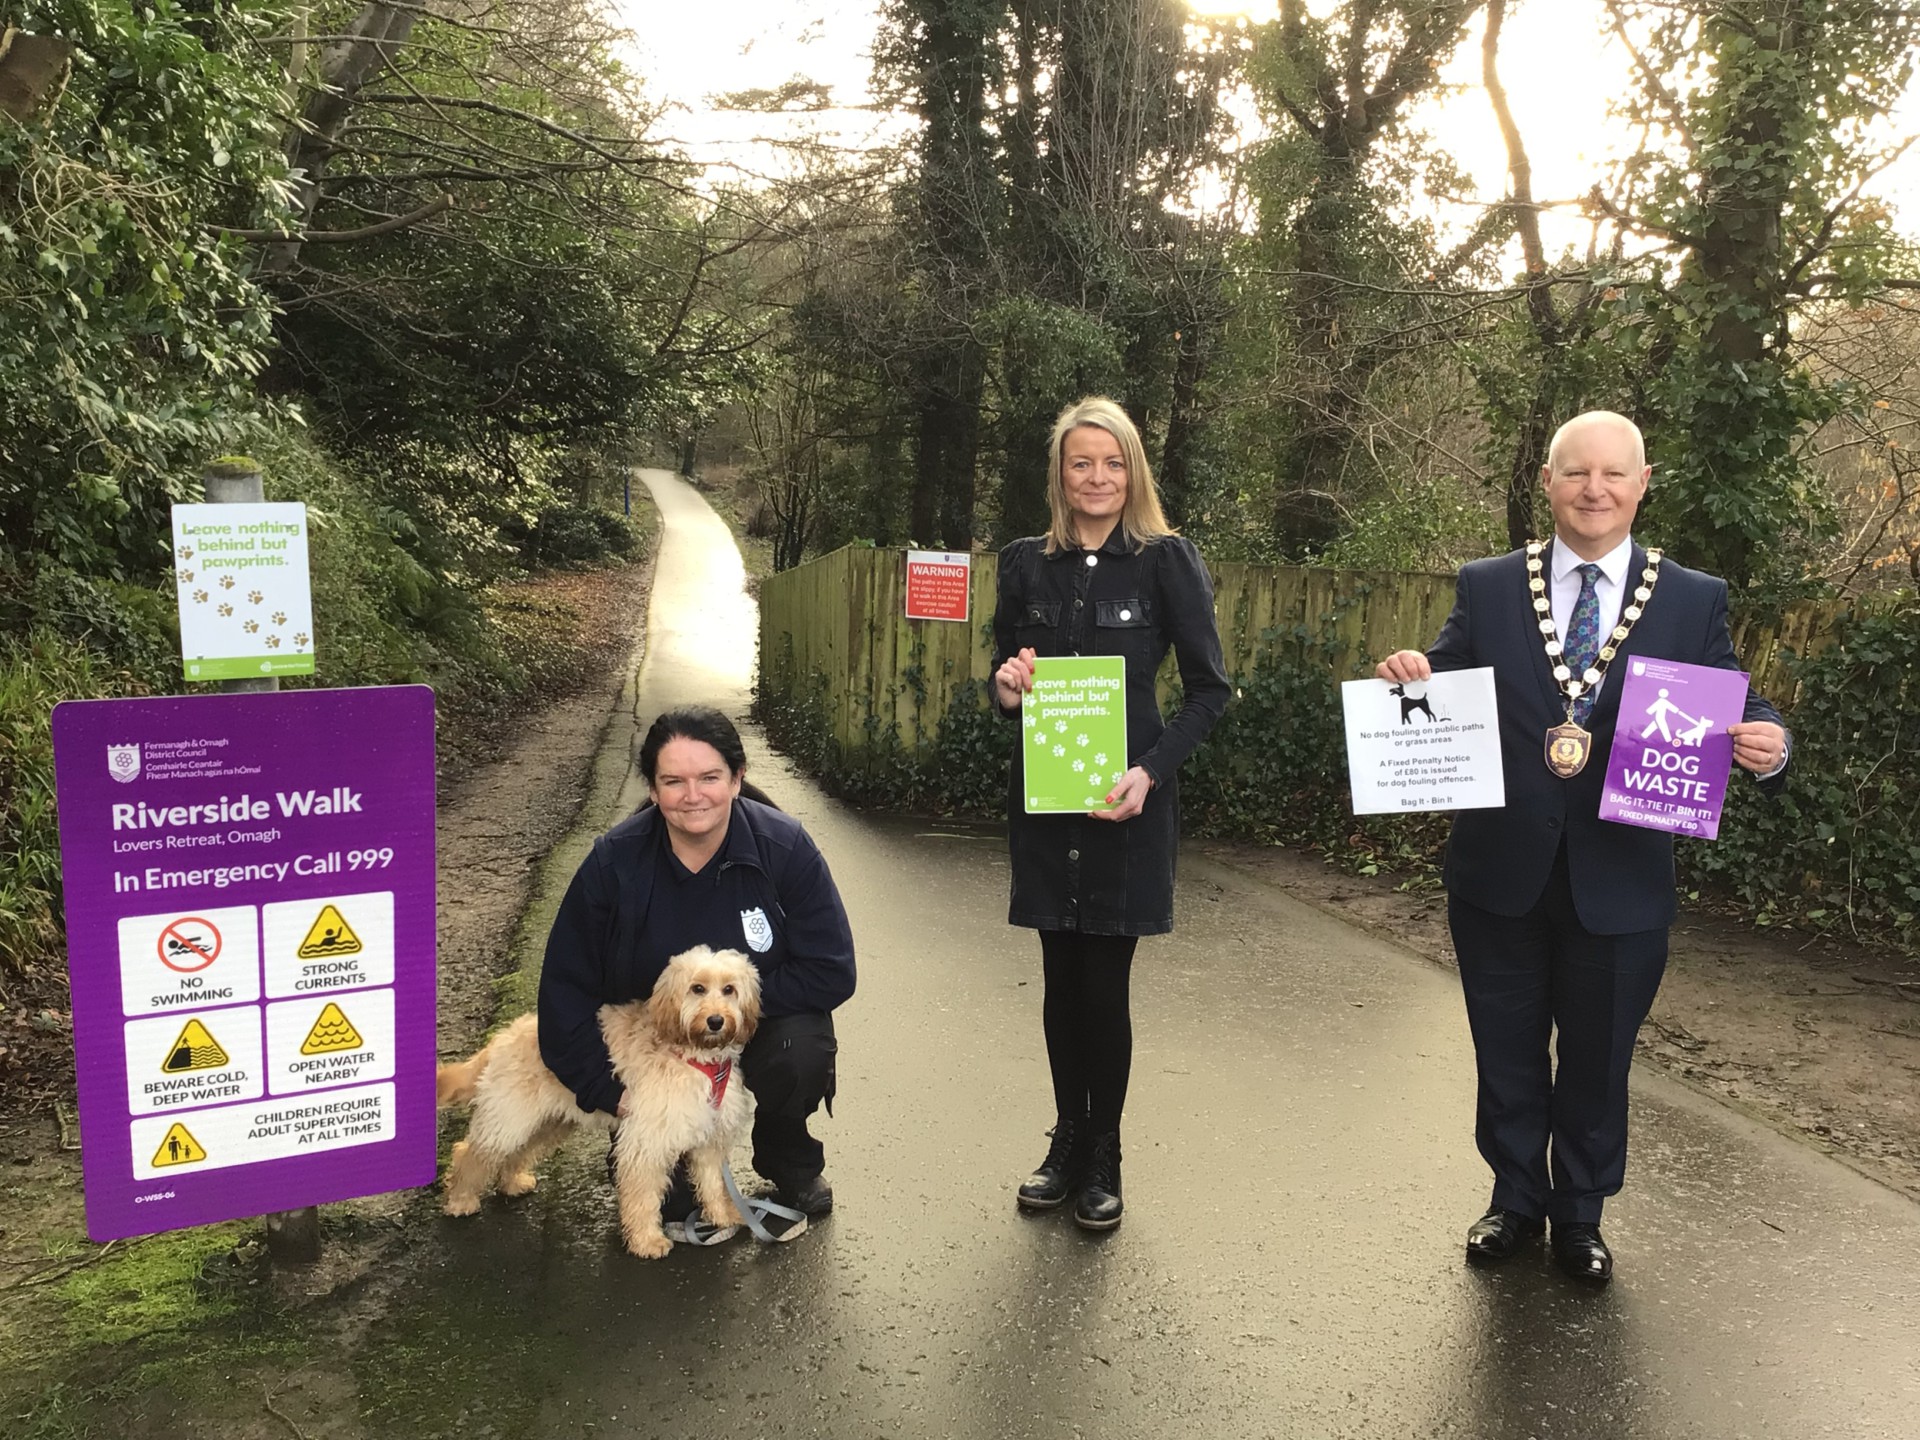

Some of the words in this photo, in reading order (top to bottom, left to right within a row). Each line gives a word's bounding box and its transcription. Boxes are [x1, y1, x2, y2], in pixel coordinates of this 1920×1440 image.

[182, 522, 232, 535] Leave
[238, 521, 300, 536] nothing
[198, 537, 255, 551] behind
[261, 537, 287, 550] but
[202, 554, 289, 571] pawprints.
[912, 565, 964, 578] WARNING
[1032, 679, 1067, 689] eave
[1071, 676, 1120, 690] nothing
[1040, 690, 1084, 702] behind
[1088, 690, 1109, 702] but
[1042, 705, 1110, 719] pawprints.
[1374, 731, 1390, 739] dog
[1392, 728, 1420, 737] fouling
[1435, 725, 1460, 734] public
[1462, 723, 1485, 732] paths
[144, 739, 191, 750] Fermanagh
[191, 739, 198, 748] &
[199, 738, 229, 748] Omagh
[1405, 738, 1428, 747] grass
[1430, 736, 1452, 744] areas
[145, 750, 175, 759] District
[176, 749, 207, 757] Council
[1388, 758, 1410, 766] Fixed
[1412, 756, 1442, 765] Penalty
[1444, 755, 1471, 763] Notice
[1641, 747, 1700, 775] DOG
[145, 762, 188, 772] Comhairle
[188, 760, 223, 769] Ceantair
[1404, 768, 1419, 776] £80
[1430, 765, 1457, 774] issued
[146, 771, 170, 780] Fhear
[170, 770, 203, 779] Manach
[204, 769, 222, 778] agus
[1391, 779, 1407, 787] dog
[1408, 777, 1437, 786] fouling
[1439, 775, 1476, 784] offences.
[1624, 768, 1710, 802] WASTE
[112, 794, 270, 830] Riverside
[276, 787, 363, 817] Walk
[1401, 798, 1417, 807] Bag
[1419, 797, 1424, 805] It
[1610, 793, 1632, 806] BAG
[1646, 799, 1663, 811] TIE
[1676, 805, 1696, 817] BIN
[1697, 809, 1712, 820] IT!
[1618, 809, 1643, 820] FIXED
[1644, 814, 1681, 827] PENALTY
[1682, 820, 1698, 830] £80
[113, 839, 163, 853] Lovers
[166, 833, 225, 848] Retreat,
[228, 827, 281, 843] Omagh
[114, 871, 139, 893] In
[145, 862, 290, 888] Emergency
[294, 851, 341, 875] Call
[347, 847, 394, 871] 999
[302, 960, 358, 976] STRONG
[180, 977, 203, 989] NO
[295, 973, 366, 990] CURRENTS
[151, 987, 233, 1007] SWIMMING
[288, 1059, 326, 1073] OPEN
[329, 1052, 375, 1067] WATER
[144, 1076, 205, 1093] BEWARE
[207, 1071, 248, 1084] COLD,
[305, 1067, 359, 1084] NEARBY
[153, 1092, 189, 1106] DEEP
[192, 1085, 240, 1100] WATER
[254, 1106, 322, 1125] CHILDREN
[324, 1096, 381, 1114] REQUIRE
[248, 1124, 292, 1139] ADULT
[294, 1109, 381, 1132] SUPERVISION
[298, 1133, 315, 1144] AT
[317, 1129, 340, 1142] ALL
[342, 1122, 382, 1137] TIMES
